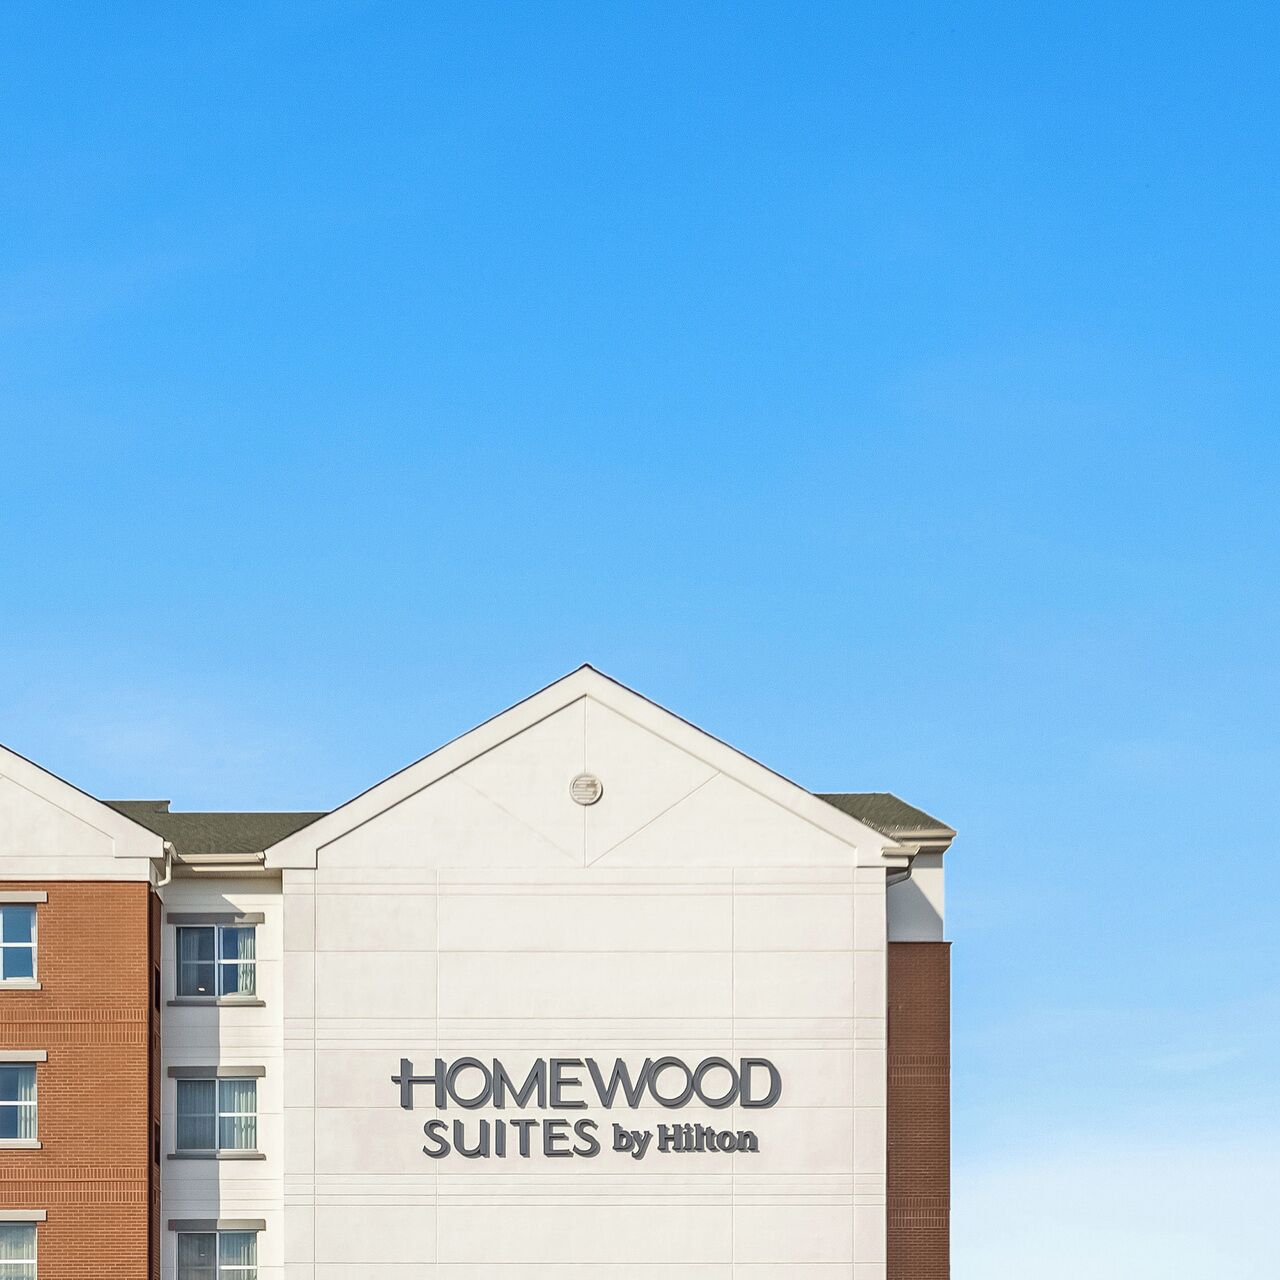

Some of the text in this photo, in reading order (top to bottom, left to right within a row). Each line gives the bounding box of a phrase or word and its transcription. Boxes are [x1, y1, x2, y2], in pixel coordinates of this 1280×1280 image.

[391, 1056, 782, 1110] HOMEWOOD
[422, 1118, 760, 1160] SUITES by Hilton
